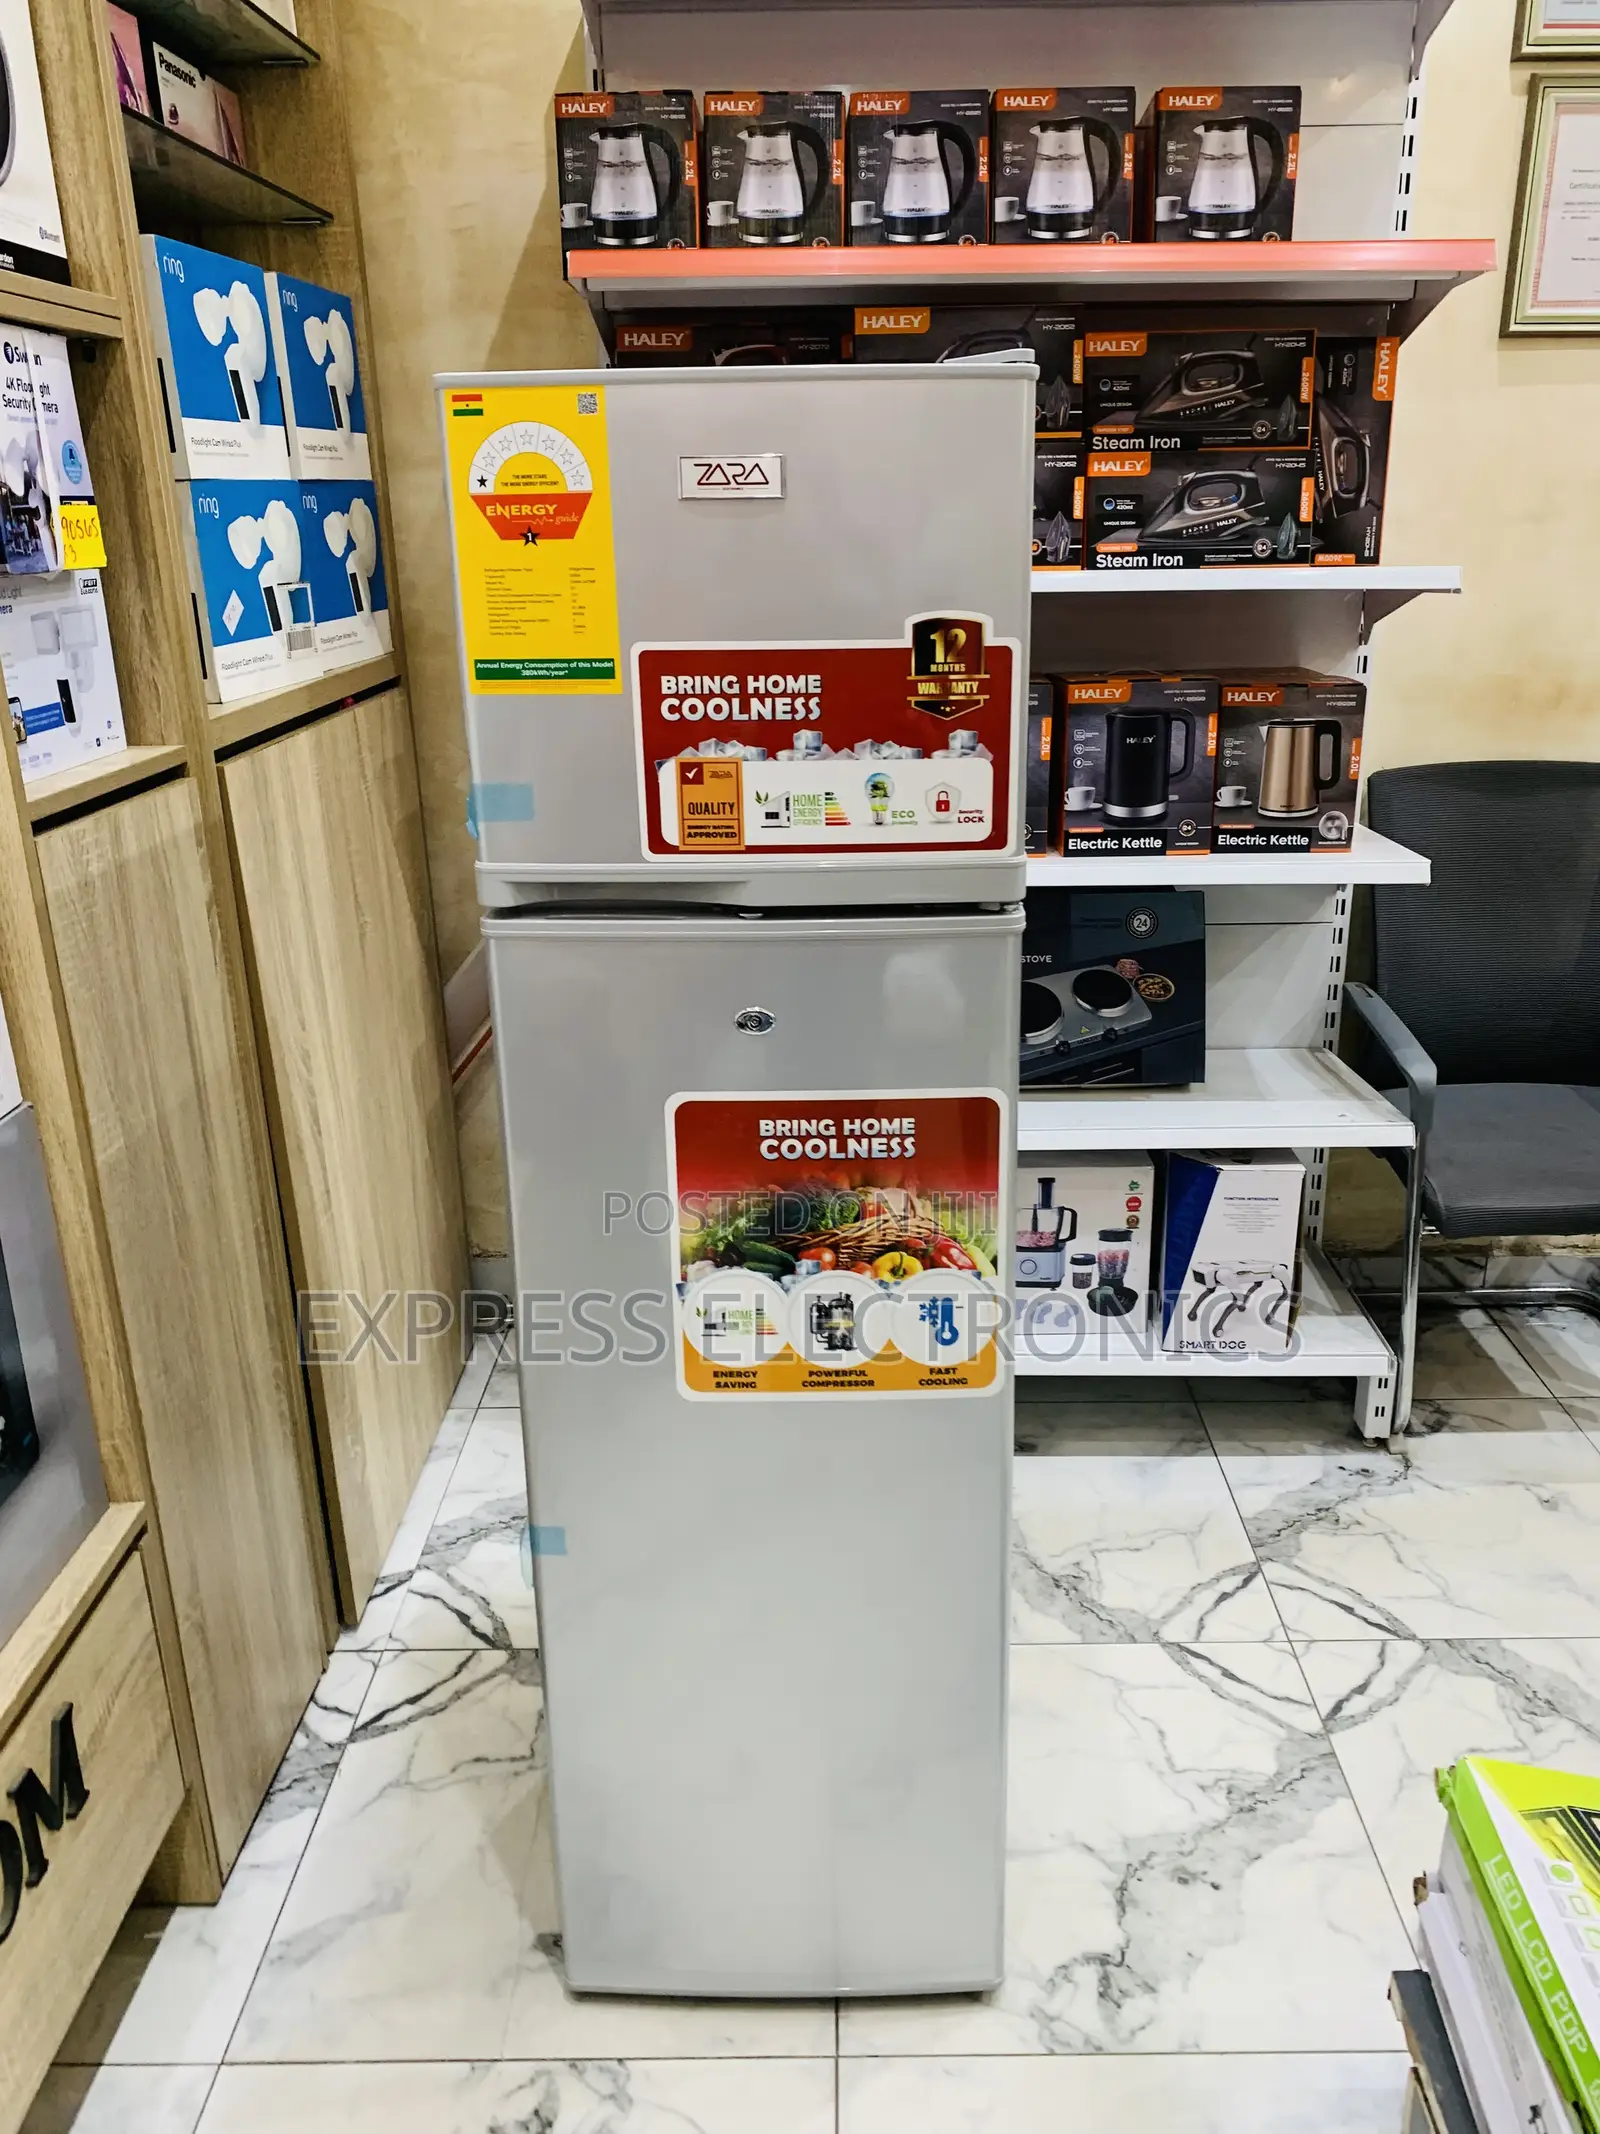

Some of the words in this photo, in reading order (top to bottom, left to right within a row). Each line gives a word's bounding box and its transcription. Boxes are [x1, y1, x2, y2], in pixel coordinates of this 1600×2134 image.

[158, 51, 197, 88] Panasonic
[710, 100, 757, 112] HALEY
[857, 99, 902, 112] HALEY
[1003, 95, 1050, 107] HALEY
[1168, 95, 1215, 106] HALEY
[561, 102, 607, 115] HALEY
[163, 252, 185, 283] ring
[282, 289, 298, 313] ring
[863, 314, 925, 329] HALEY
[624, 332, 686, 347] HALEY
[1089, 340, 1141, 352] HALEY
[1376, 342, 1391, 398] HALEY
[5, 376, 16, 390] 4K
[2, 393, 31, 413] Security
[1214, 398, 1236, 410] HALEY
[1092, 435, 1145, 451] Steam
[1150, 435, 1181, 449] Iron
[1093, 459, 1145, 473] HALEY
[693, 462, 769, 486] ZARA
[199, 493, 220, 519] ring
[302, 492, 318, 513] ring
[486, 501, 558, 519] ENERGY
[1216, 517, 1238, 528] HALEY
[527, 532, 532, 541] 1
[1096, 554, 1149, 569] Steam
[1153, 553, 1184, 568] Iron
[930, 628, 967, 663] 12
[500, 662, 523, 670] Energy
[524, 661, 568, 670] Consumption
[592, 660, 614, 668] Model
[930, 663, 966, 672] MONTHS
[661, 675, 740, 695] BRING
[747, 674, 822, 694] HOME
[1074, 687, 1123, 700] HALEY
[1227, 690, 1276, 703] HALEY
[660, 697, 822, 722] COOLNESS
[1126, 735, 1154, 745] HALEY
[1208, 731, 1217, 751] 2.0L
[1350, 755, 1360, 775] 2.0L
[793, 794, 822, 807] HOME
[688, 801, 735, 815] QUALITY
[793, 807, 822, 818] ENERGY
[891, 810, 915, 819] ECO
[957, 815, 985, 823] LOCK
[687, 831, 737, 839] APPROVED
[1217, 834, 1267, 846] Electric
[1270, 833, 1309, 845] Kettle
[1068, 837, 1119, 850] Electric
[1122, 836, 1163, 849] Kettle
[1135, 917, 1149, 929] 24
[1020, 954, 1053, 964] STOVE
[758, 1119, 836, 1137] BRING
[842, 1117, 916, 1135] HOME
[758, 1137, 916, 1160] COOLNESS
[1179, 1340, 1216, 1350] SMART
[1218, 1340, 1247, 1350] DOG
[713, 1370, 758, 1379] ENERGY
[808, 1369, 868, 1378] POWERFUL
[929, 1367, 957, 1375] FAST
[715, 1380, 757, 1389] SAVING
[802, 1379, 875, 1388] COMPRESSOR
[919, 1377, 968, 1386] COOLING
[1488, 1853, 1523, 1910] LED
[1517, 1919, 1554, 1980] LCD
[1550, 1991, 1588, 2053] PDP
